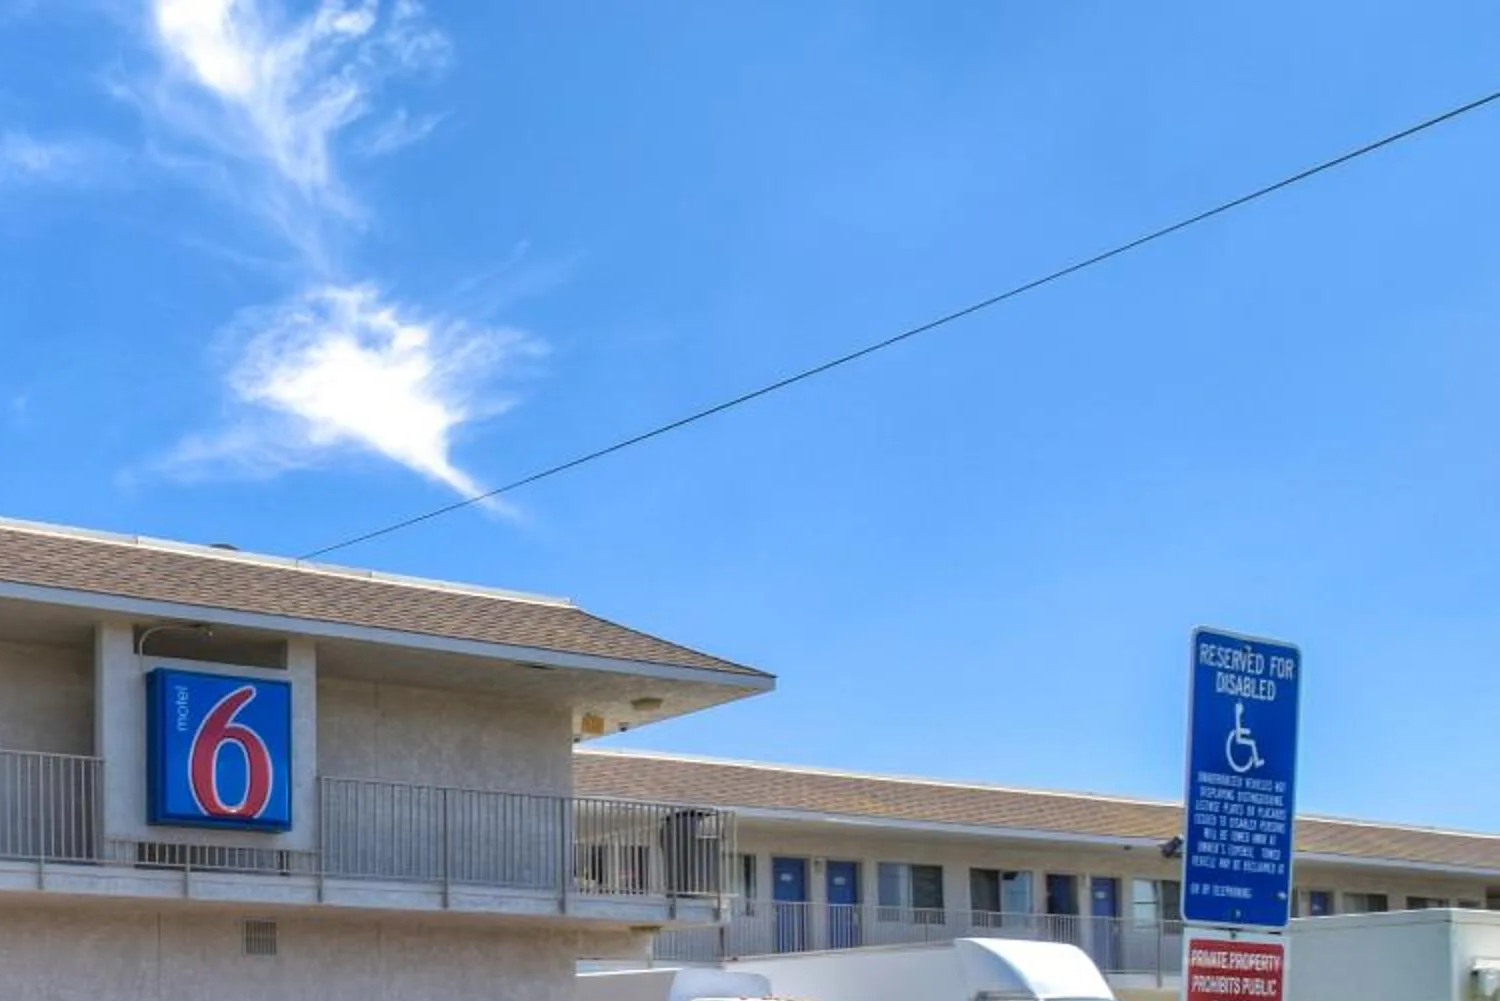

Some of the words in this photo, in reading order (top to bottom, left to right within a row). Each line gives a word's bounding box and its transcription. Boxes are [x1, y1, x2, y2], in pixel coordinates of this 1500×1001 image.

[1200, 643, 1265, 675] RESERVED
[1269, 656, 1294, 680] FOR
[1215, 671, 1276, 701] DISABLED
[175, 685, 189, 732] motel
[188, 685, 273, 818] 6
[1192, 950, 1229, 969] PRIVATE
[1230, 952, 1281, 972] PROPERTY
[1191, 975, 1240, 995] PROHIBITS
[1242, 977, 1277, 997] PUBLIC
